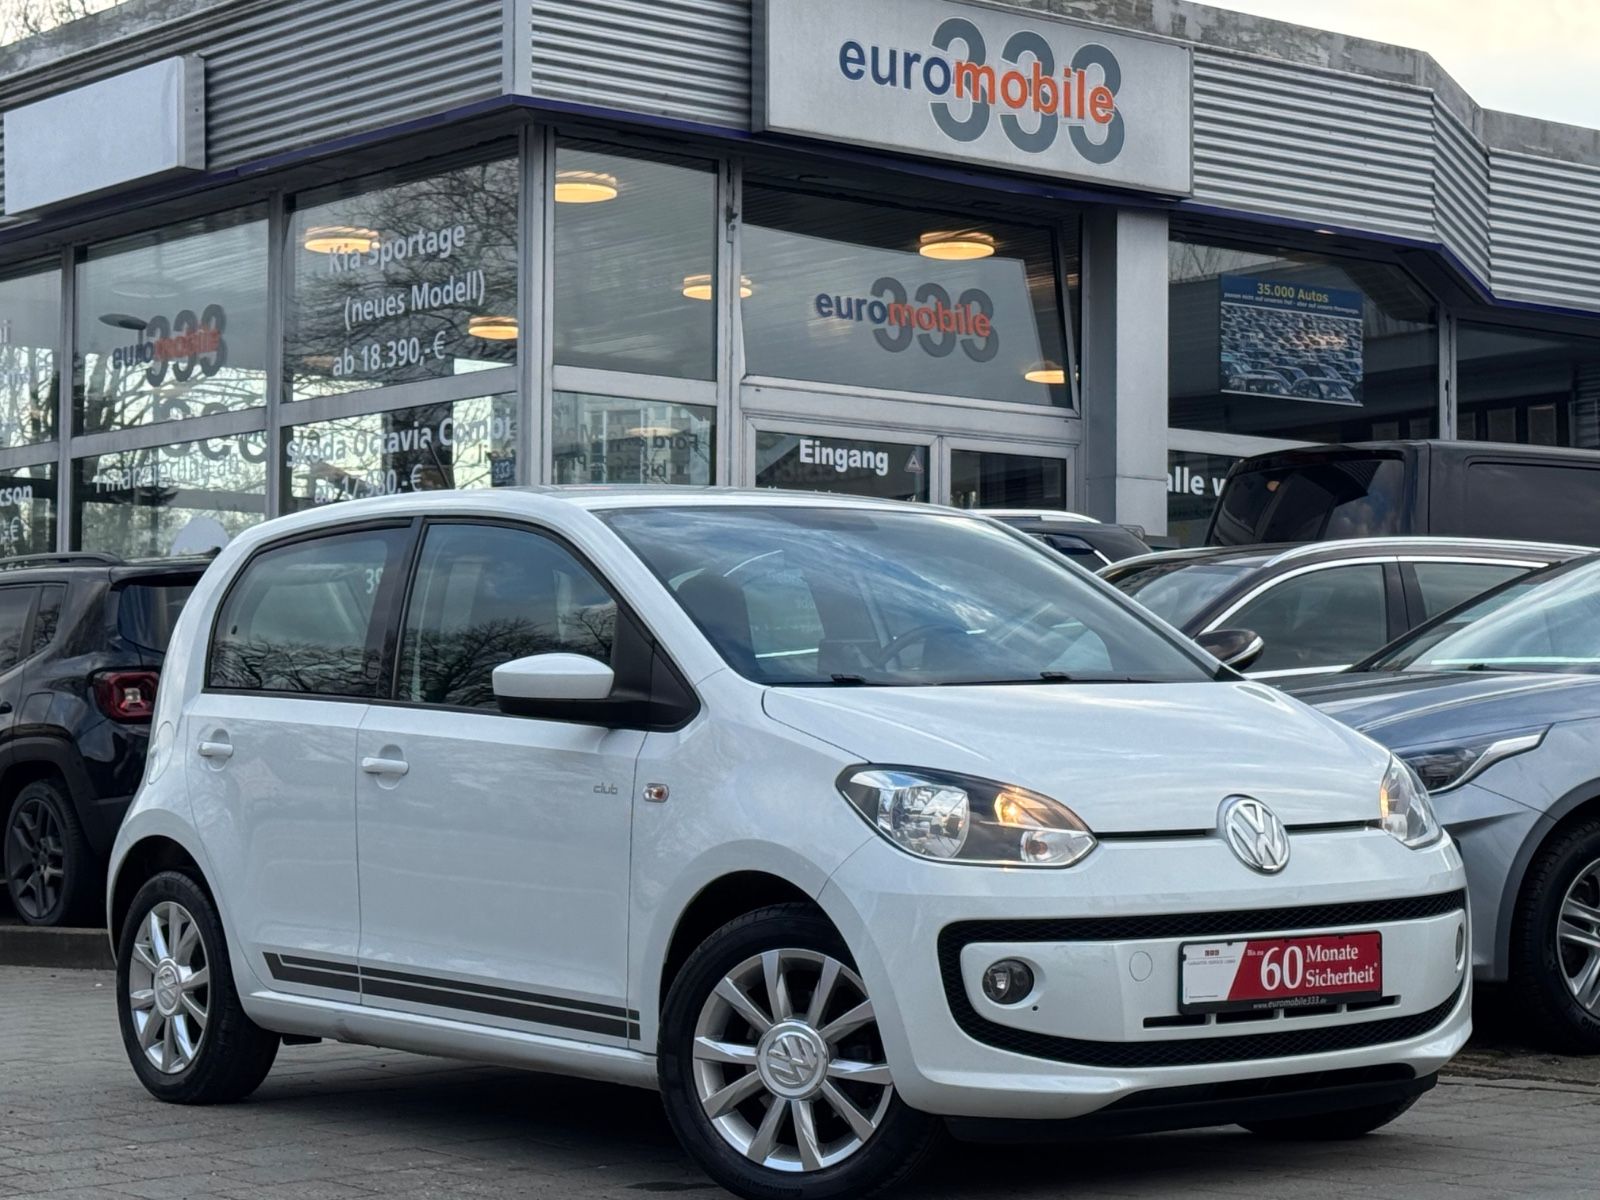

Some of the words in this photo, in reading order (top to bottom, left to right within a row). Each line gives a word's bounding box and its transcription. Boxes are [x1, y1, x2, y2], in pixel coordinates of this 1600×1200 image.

[839, 40, 1114, 124] euromobile
[930, 17, 1125, 165] 333
[329, 243, 361, 273] Kia
[366, 224, 466, 270] Sportage
[344, 294, 405, 331] (neues
[411, 269, 485, 311] Modell)
[815, 293, 991, 337] euromobile
[1257, 282, 1295, 299] 35.000
[1297, 288, 1329, 303] Autos
[870, 276, 999, 363] 333
[332, 347, 354, 377] ab
[354, 420, 432, 458] Octavia
[438, 407, 511, 447] Combi
[800, 438, 889, 476] Eingang
[593, 782, 618, 795] club
[1260, 945, 1304, 991] 60
[1305, 944, 1359, 964] Monate
